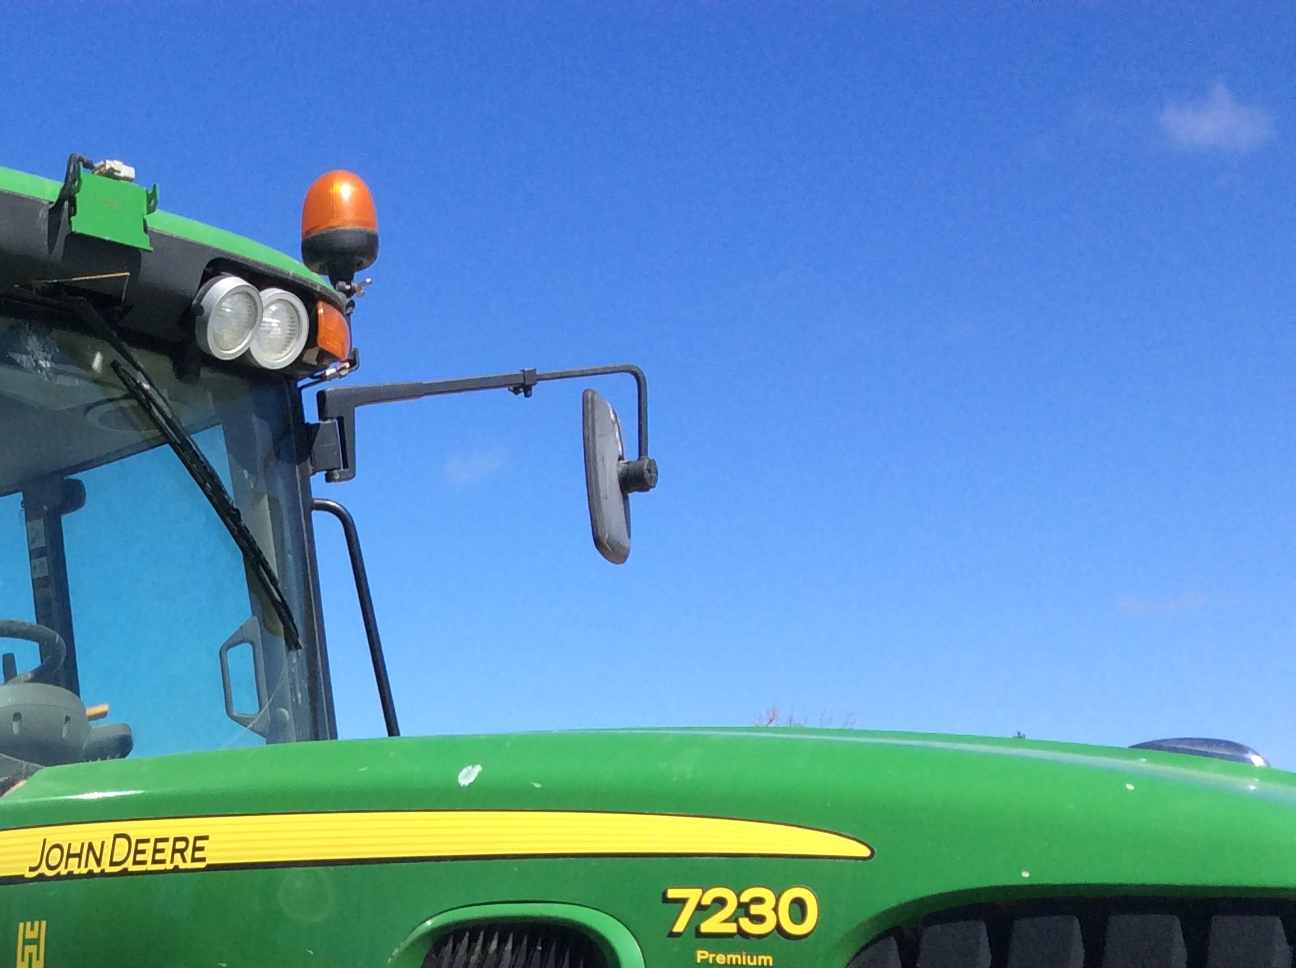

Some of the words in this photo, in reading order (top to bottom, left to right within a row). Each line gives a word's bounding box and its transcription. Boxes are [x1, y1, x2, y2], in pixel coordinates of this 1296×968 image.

[28, 838, 106, 872] JOHN
[108, 833, 209, 867] DEERE
[664, 886, 819, 938] 7230
[696, 949, 774, 967] Premium
